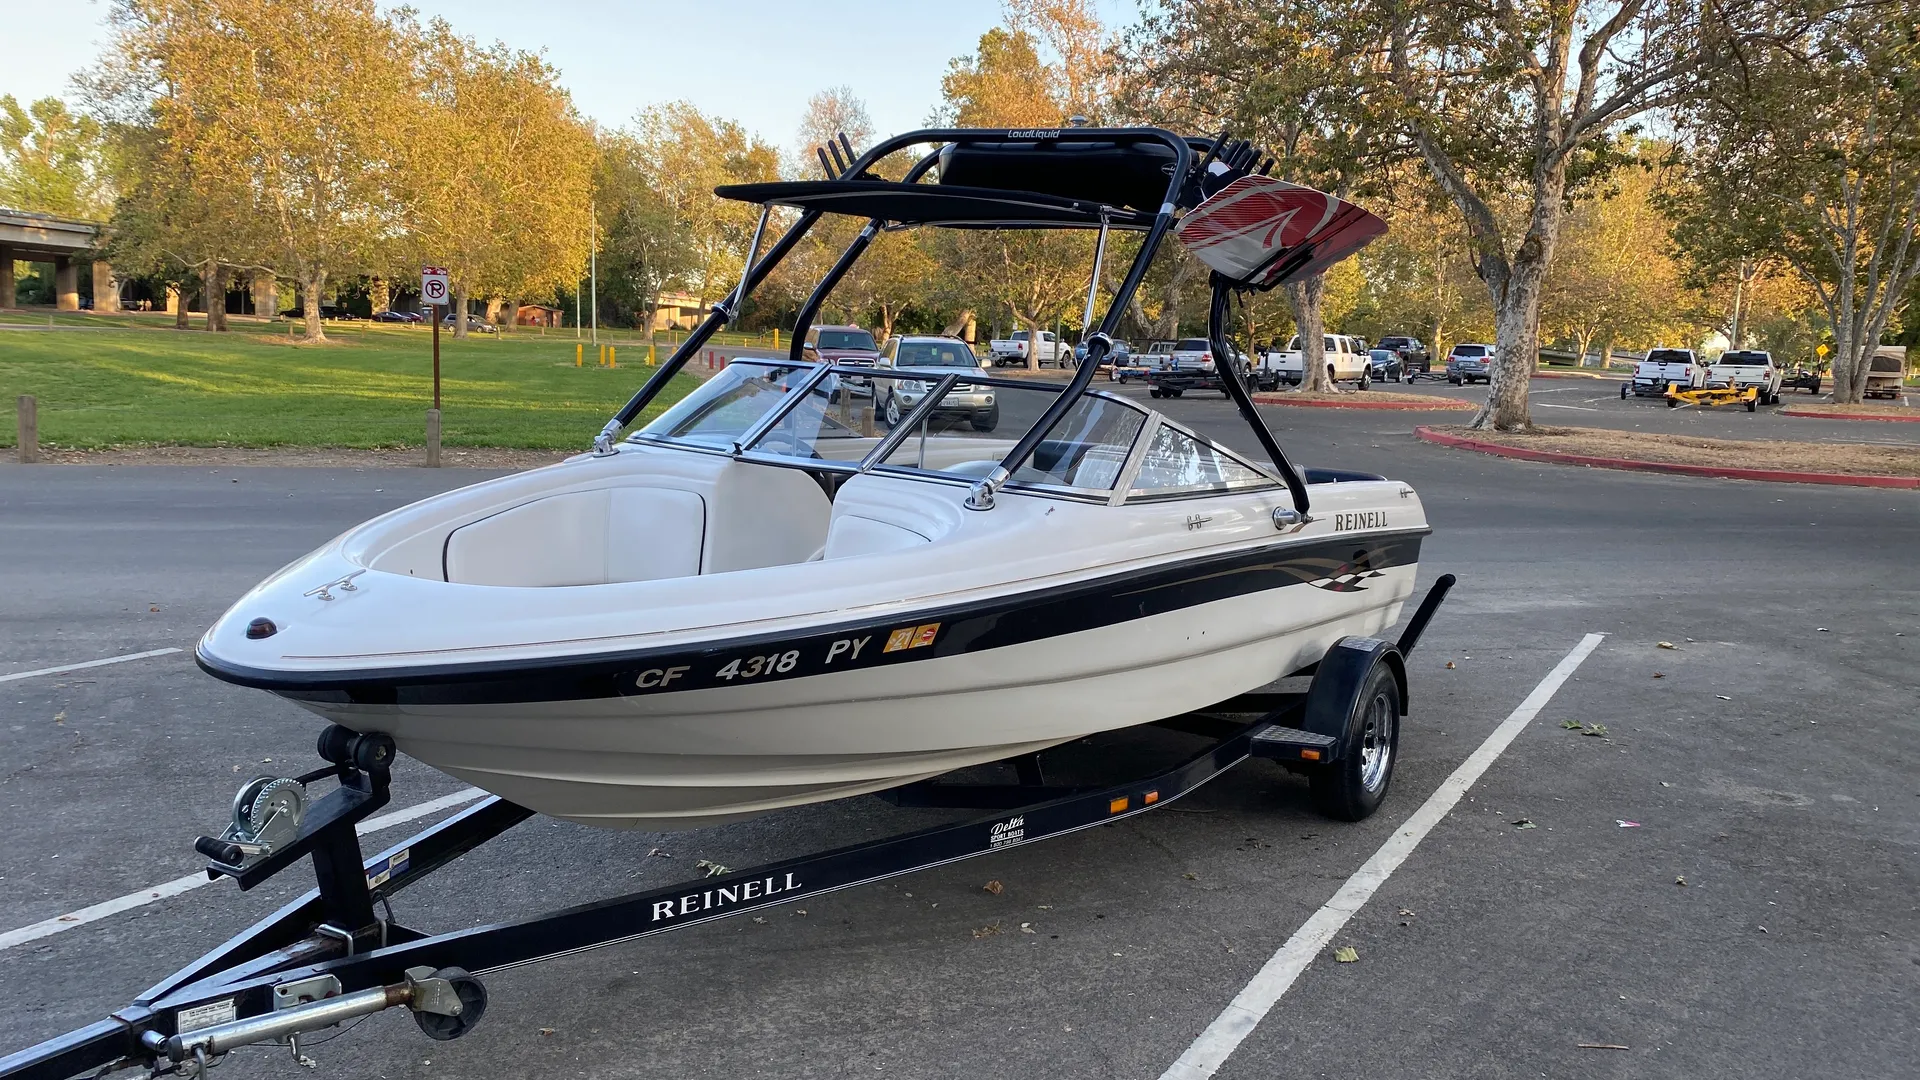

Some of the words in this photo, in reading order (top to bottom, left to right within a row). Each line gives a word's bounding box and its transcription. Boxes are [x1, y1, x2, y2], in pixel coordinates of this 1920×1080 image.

[1007, 129, 1061, 140] LoudLiquid
[1335, 512, 1388, 531] REINELL
[635, 665, 691, 688] CF
[715, 649, 800, 681] 4318
[824, 635, 872, 664] PY
[990, 814, 1024, 834] Delta
[651, 872, 803, 922] REINELL
